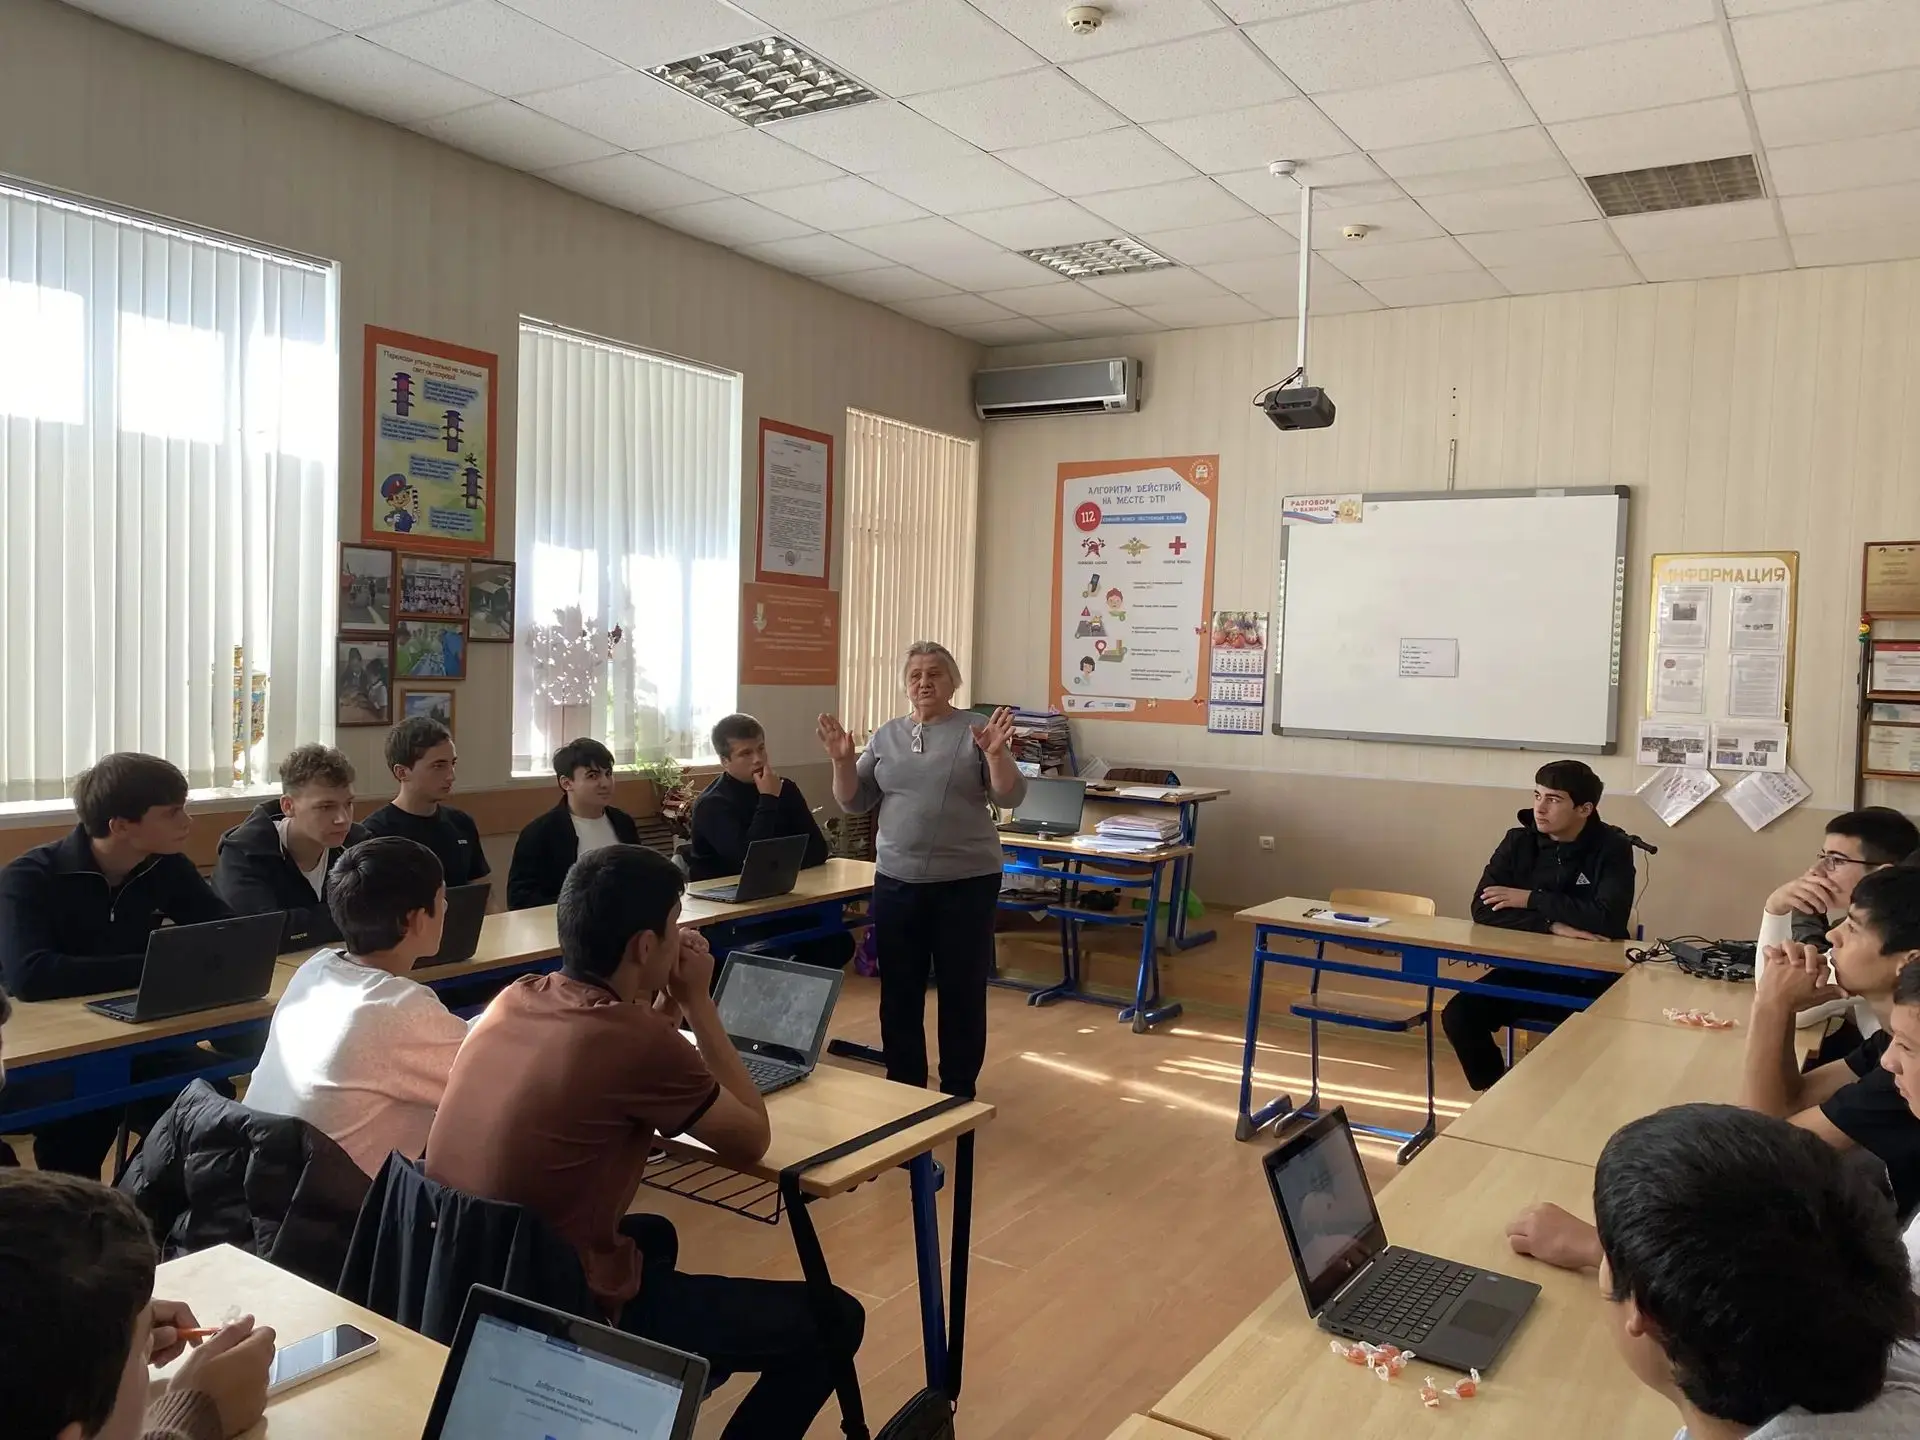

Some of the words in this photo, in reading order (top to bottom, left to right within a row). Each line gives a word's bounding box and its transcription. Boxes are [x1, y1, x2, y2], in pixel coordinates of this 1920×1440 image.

[1088, 485, 1132, 495] АЛГОРИТМ
[1136, 481, 1182, 493] ДЕЙСТВИЙ
[1102, 496, 1112, 505] НА
[1116, 495, 1145, 505] МЕСТЕ
[1150, 494, 1166, 504] ДТП
[1290, 499, 1337, 507] РАЗГОВОРЫ
[1081, 510, 1096, 524] 112
